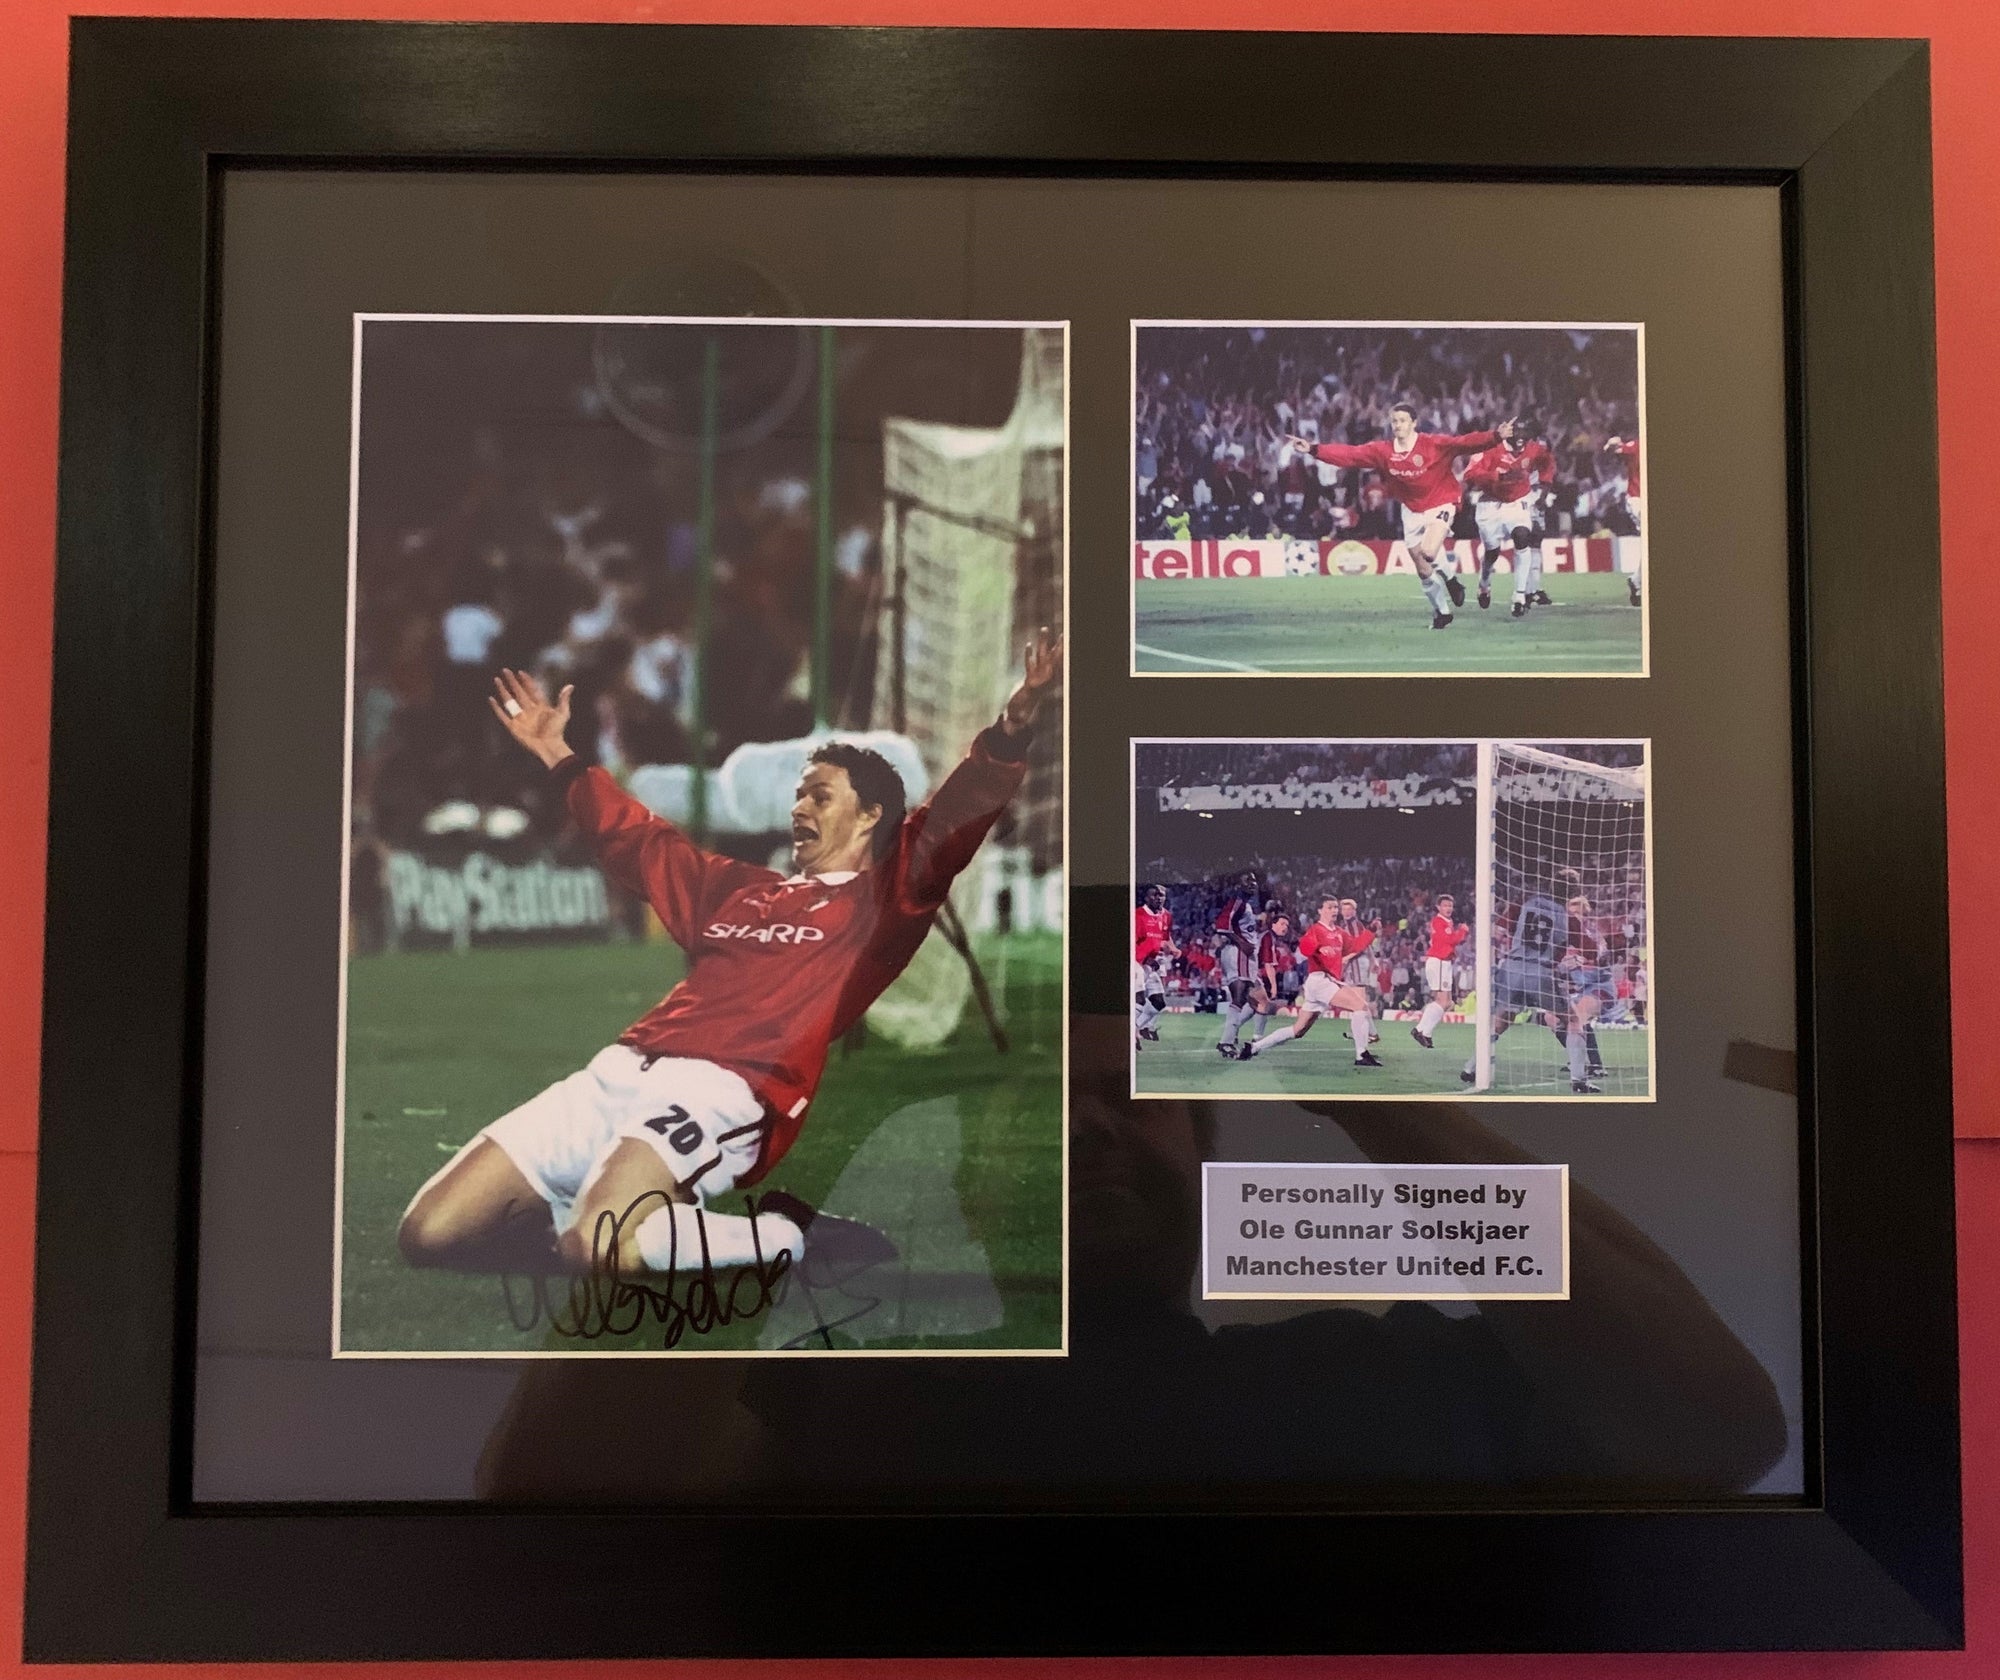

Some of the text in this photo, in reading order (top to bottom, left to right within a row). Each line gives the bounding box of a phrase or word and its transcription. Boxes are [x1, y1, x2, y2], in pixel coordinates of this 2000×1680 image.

[703, 922, 824, 944] SHARP
[643, 1103, 705, 1156] 20
[1241, 1184, 1527, 1209] Personally Signed by
[1240, 1220, 1529, 1244] Ole Gunnar Solskjaer
[1227, 1256, 1543, 1276] Manchester United F.C.
